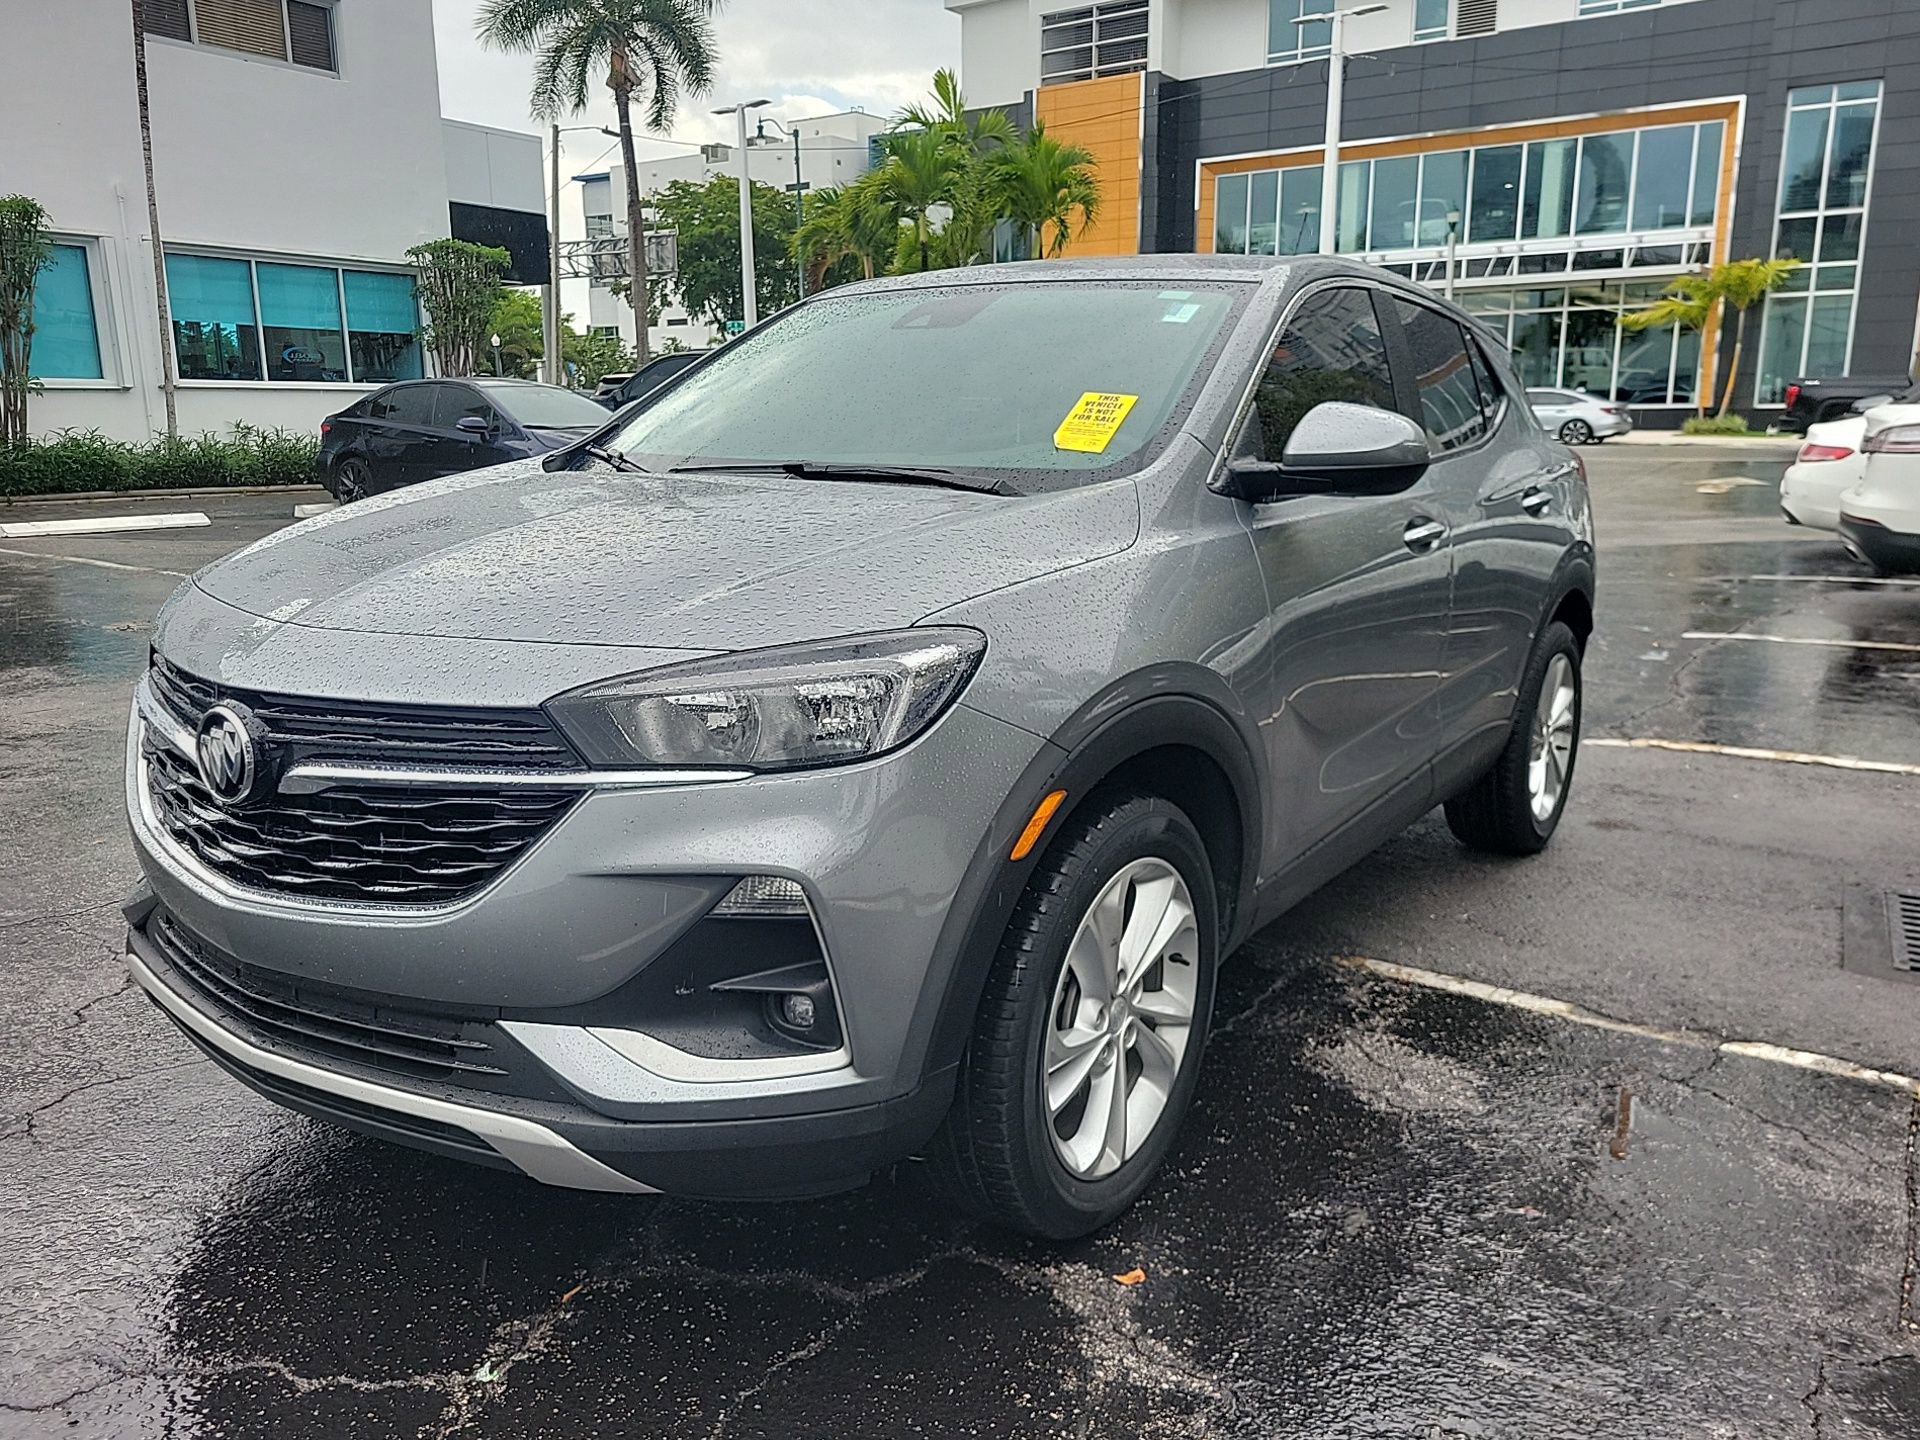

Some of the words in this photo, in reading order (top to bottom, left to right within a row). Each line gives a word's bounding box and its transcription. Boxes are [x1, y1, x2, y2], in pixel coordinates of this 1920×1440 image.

[1084, 401, 1124, 409] VEHICLE
[1095, 408, 1116, 416] NOT
[1093, 415, 1117, 423] SALE
